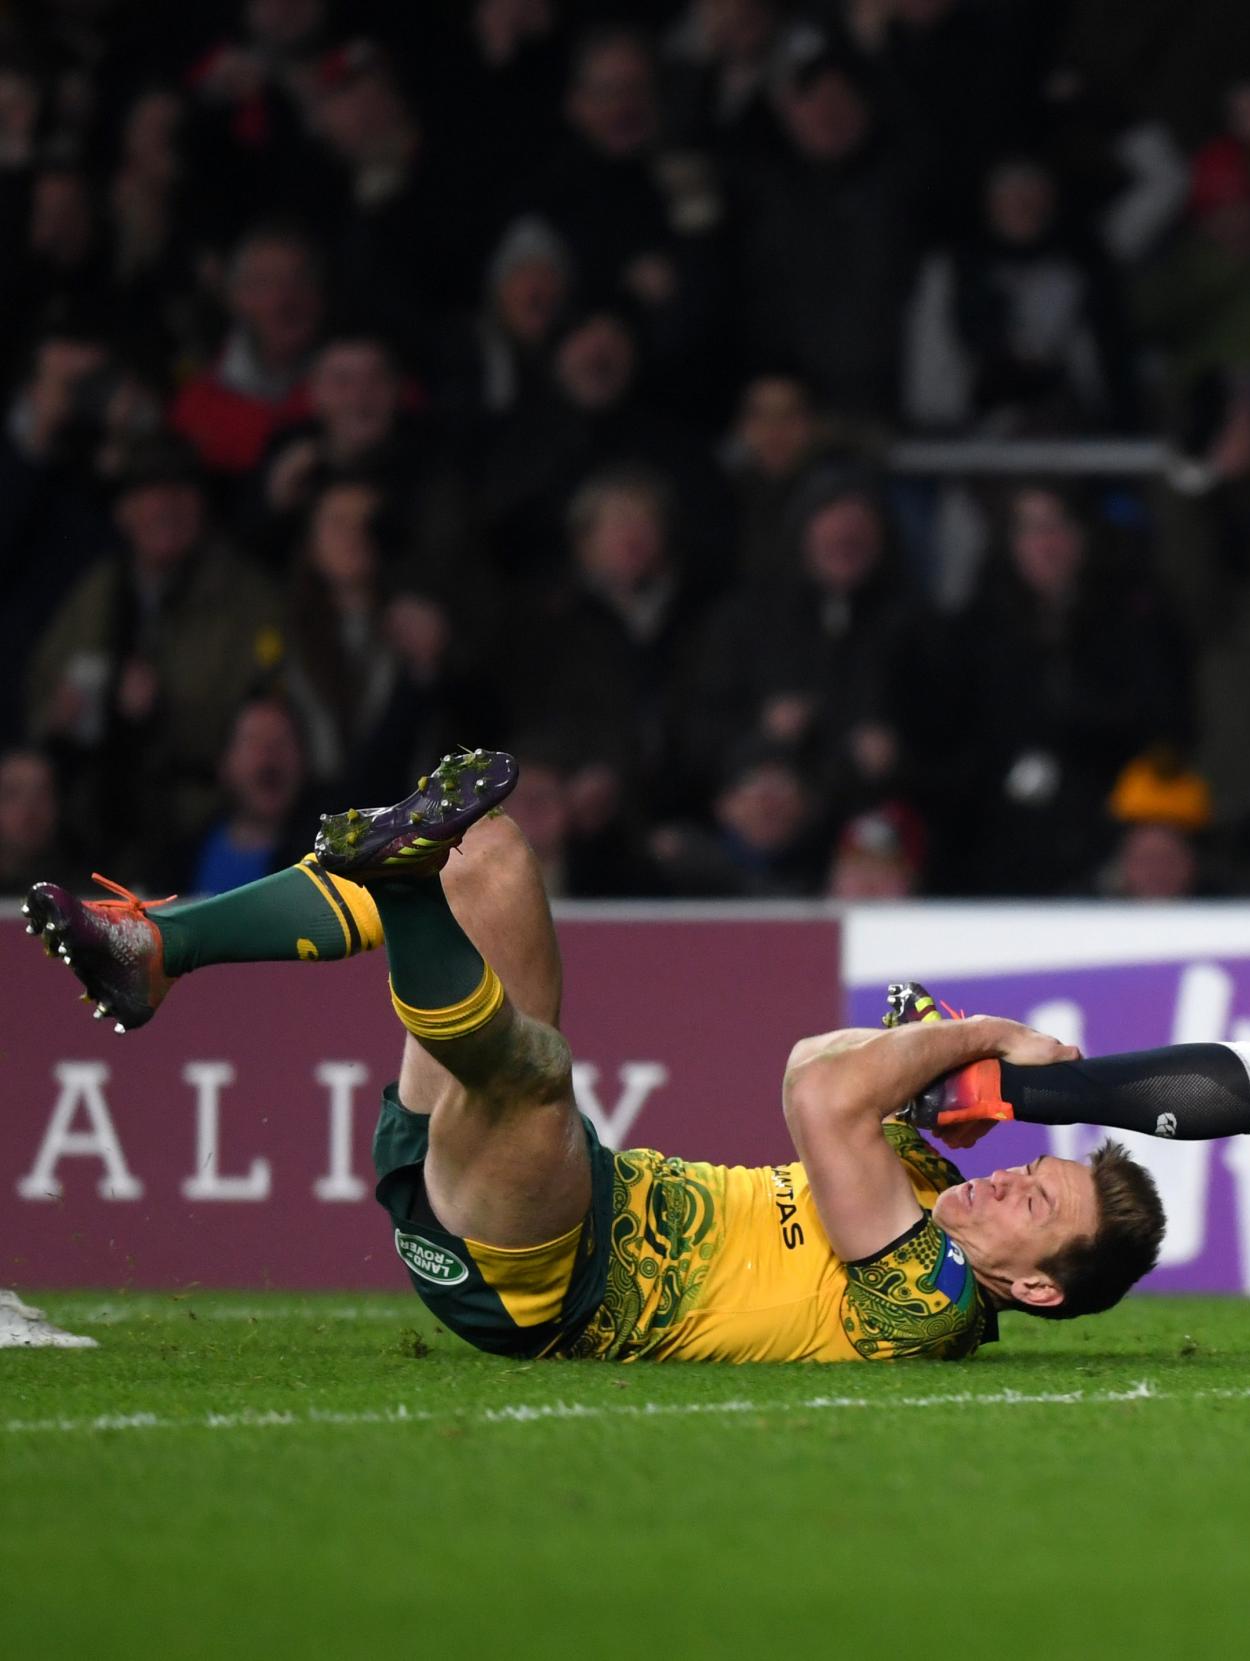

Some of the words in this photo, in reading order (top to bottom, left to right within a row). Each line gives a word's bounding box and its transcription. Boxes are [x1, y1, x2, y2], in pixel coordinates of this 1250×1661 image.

[17, 1061, 668, 1200] ALIY
[772, 1163, 804, 1250] ANTAS
[400, 1239, 445, 1264] ROVER
[414, 1254, 450, 1277] LAND
